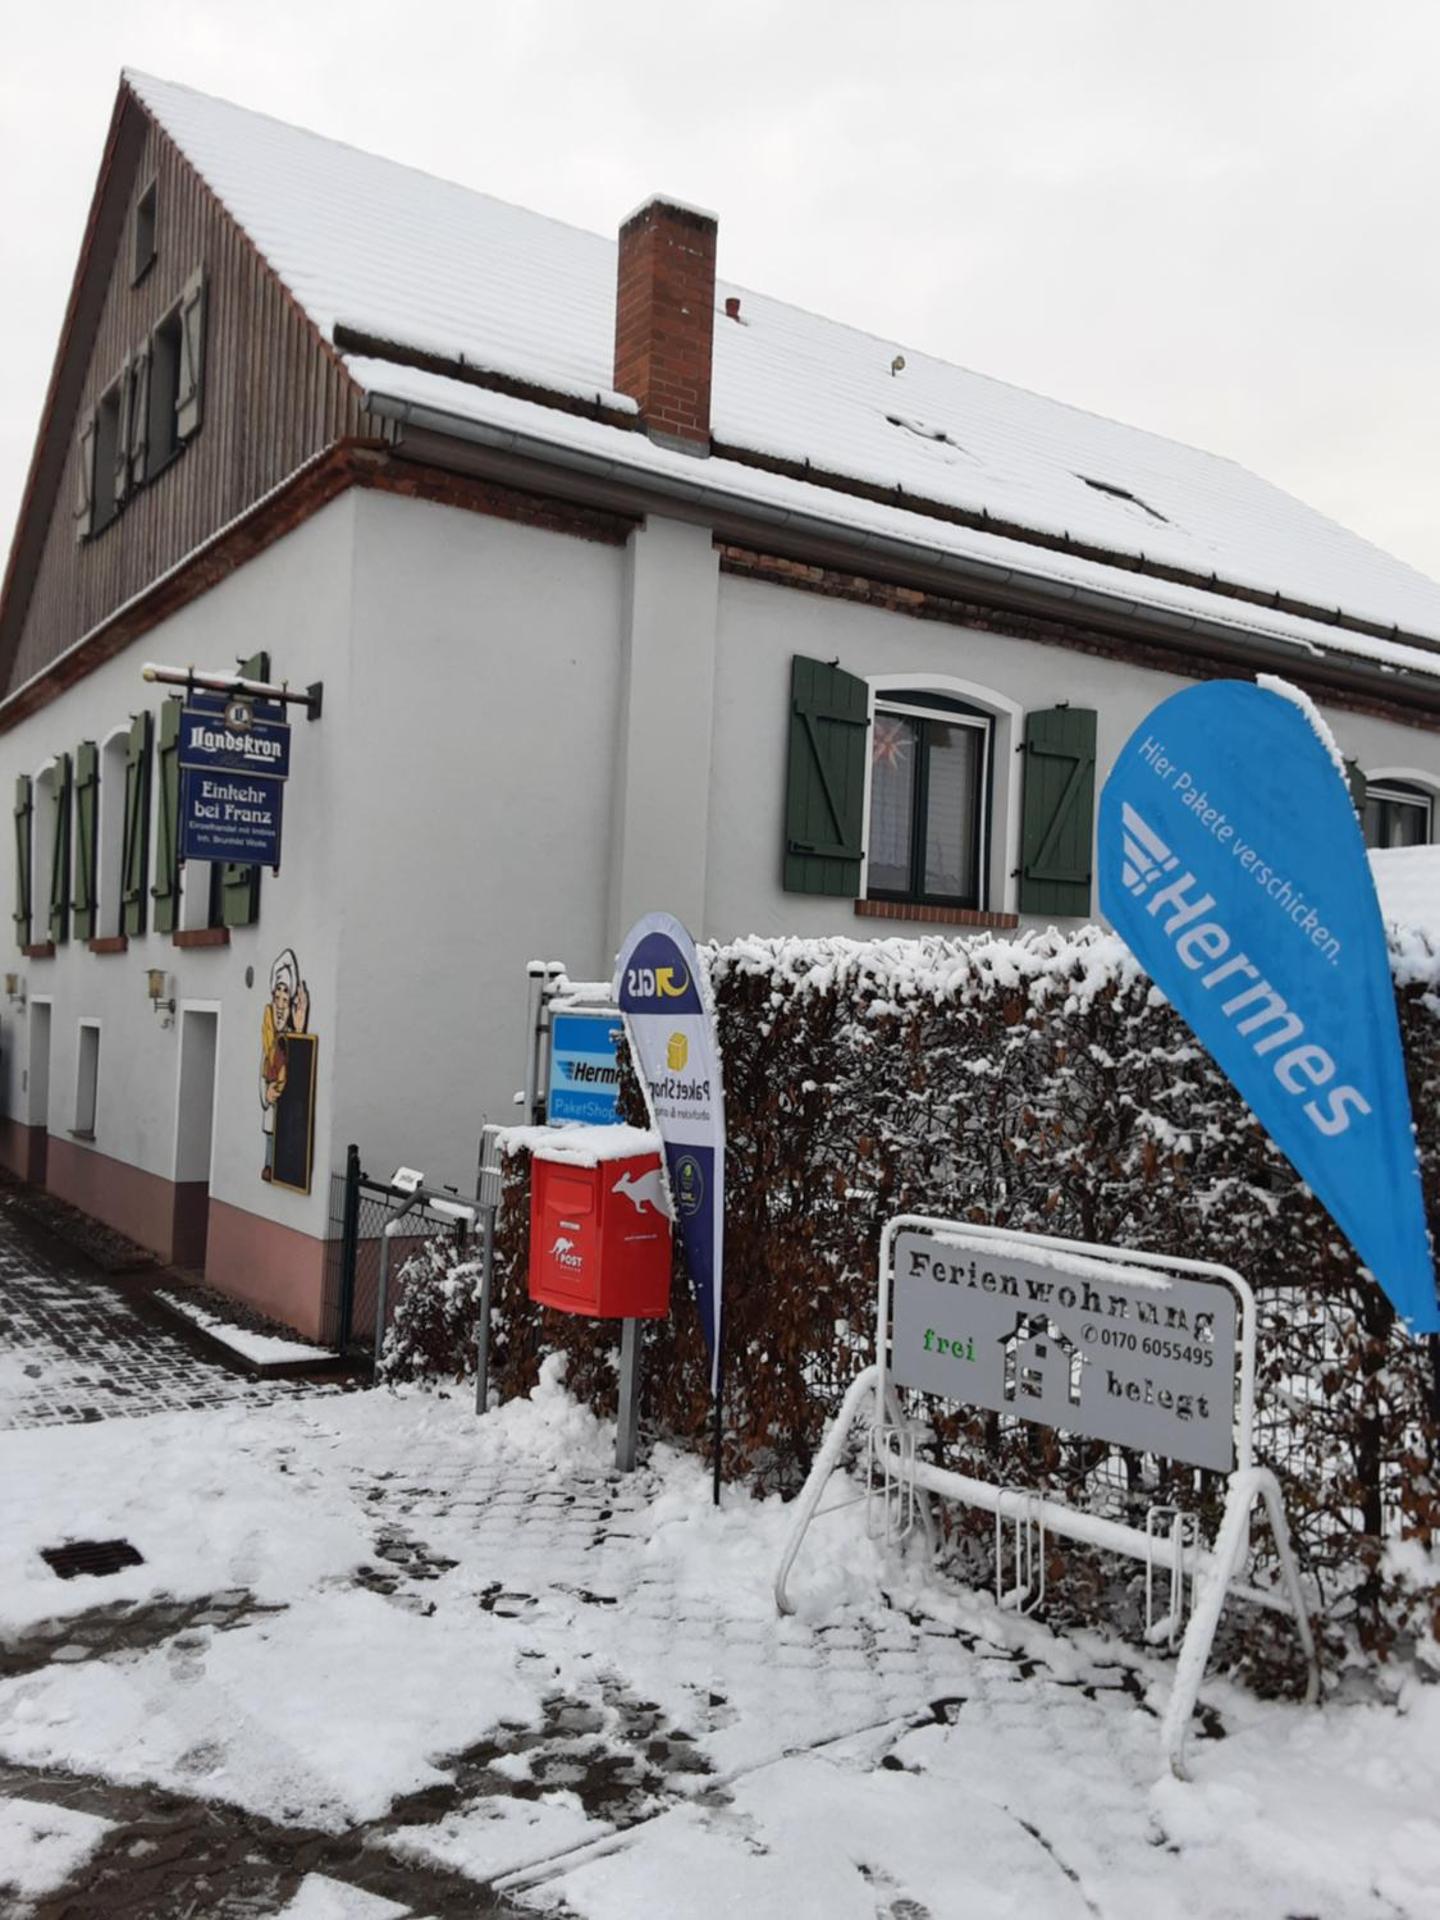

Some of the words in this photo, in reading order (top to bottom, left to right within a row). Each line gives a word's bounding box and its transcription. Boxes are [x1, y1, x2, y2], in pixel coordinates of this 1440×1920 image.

[188, 727, 282, 758] Landskron
[202, 780, 266, 804] Einkehr
[194, 800, 220, 819] bei
[224, 804, 272, 824] Franz
[1138, 735, 1176, 780] Hier
[1172, 771, 1235, 844] Pakete
[1232, 837, 1342, 967] verschicken.
[1145, 870, 1372, 1138] Hermes
[560, 1253, 583, 1267] POST
[908, 1250, 1216, 1343] Ferienwohnung
[922, 1328, 977, 1362] frei
[1100, 1328, 1137, 1352] 0170
[1142, 1340, 1215, 1368] 6055495
[1105, 1370, 1210, 1421] belegt
